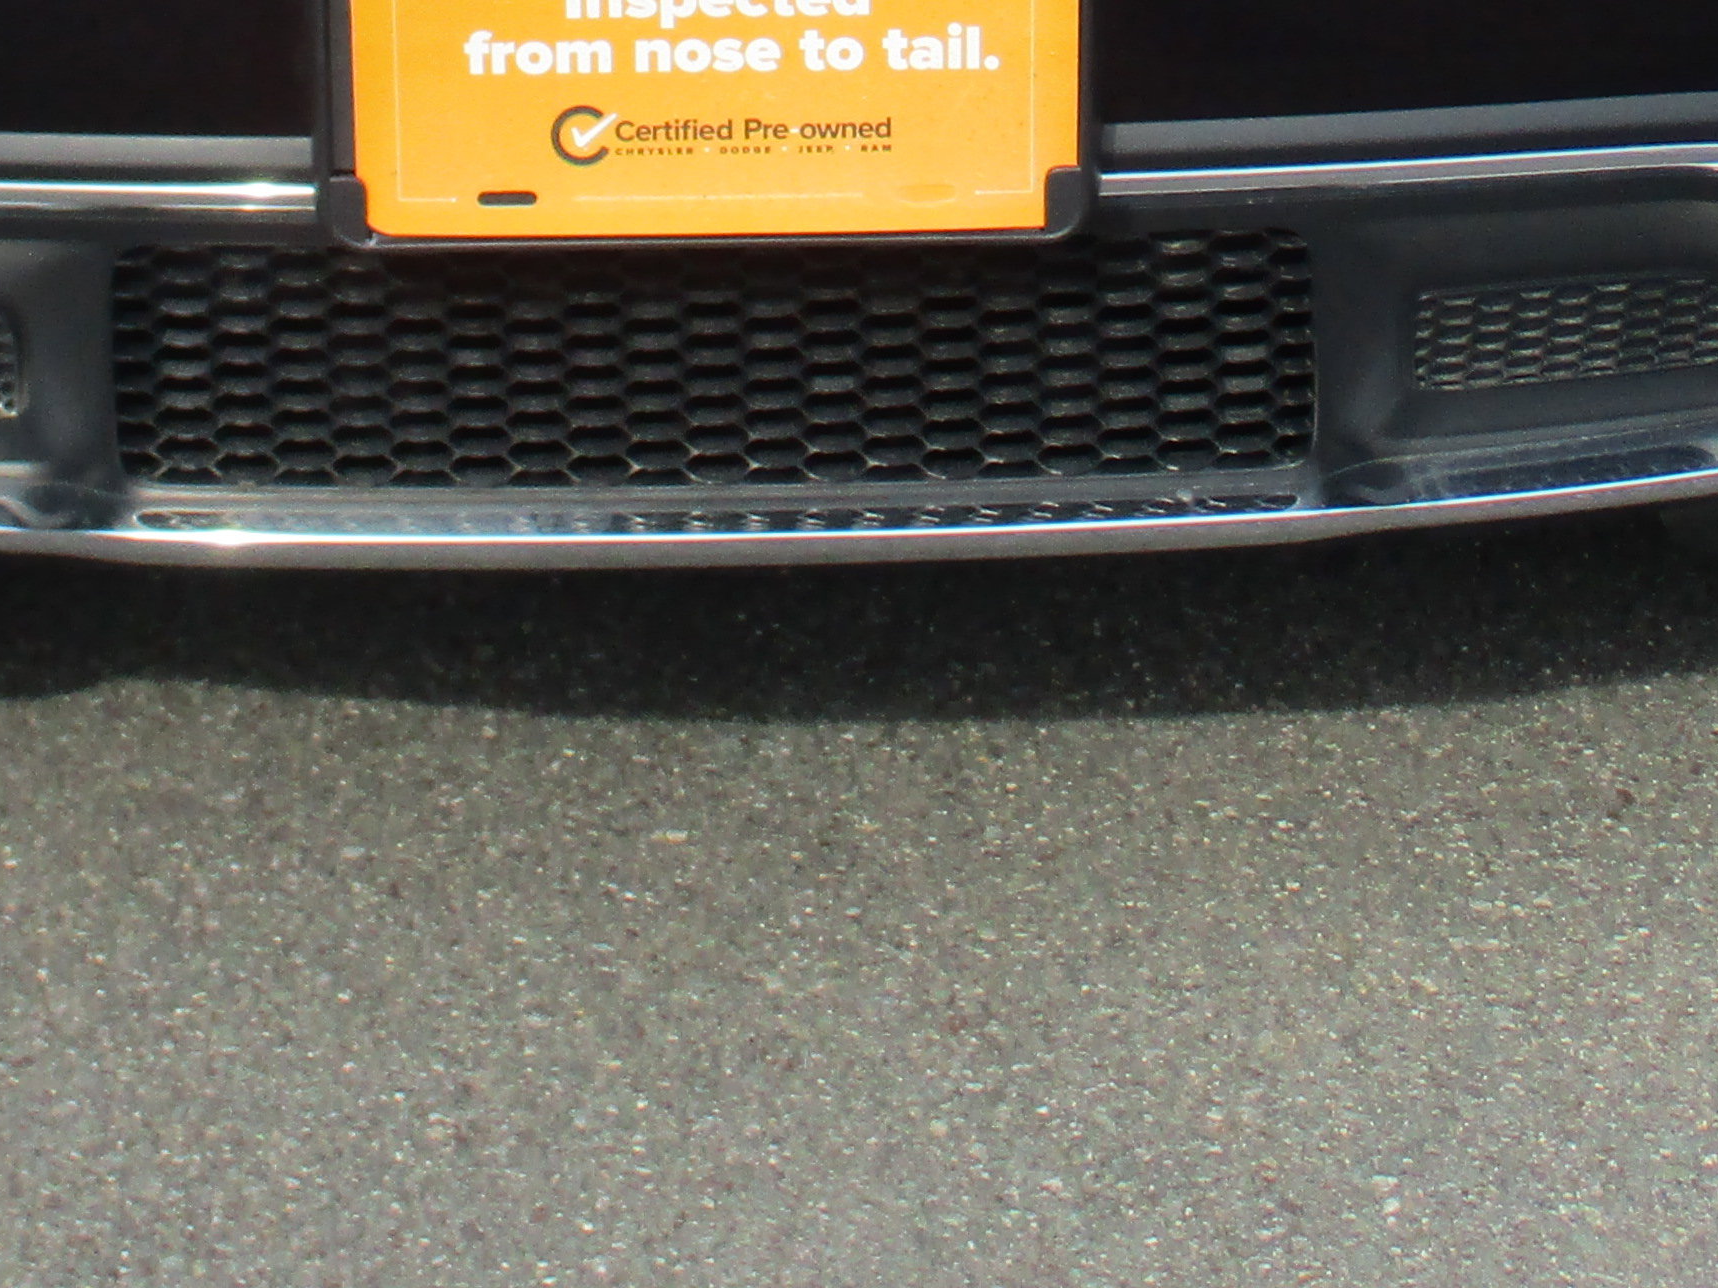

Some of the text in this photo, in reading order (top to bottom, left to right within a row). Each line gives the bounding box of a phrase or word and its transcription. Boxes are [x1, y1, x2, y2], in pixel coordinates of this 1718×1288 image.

[463, 22, 1000, 75] from nose to tail.
[615, 119, 733, 142] Certified
[614, 143, 893, 156] CHRYSLER DODGE JEEP RAM
